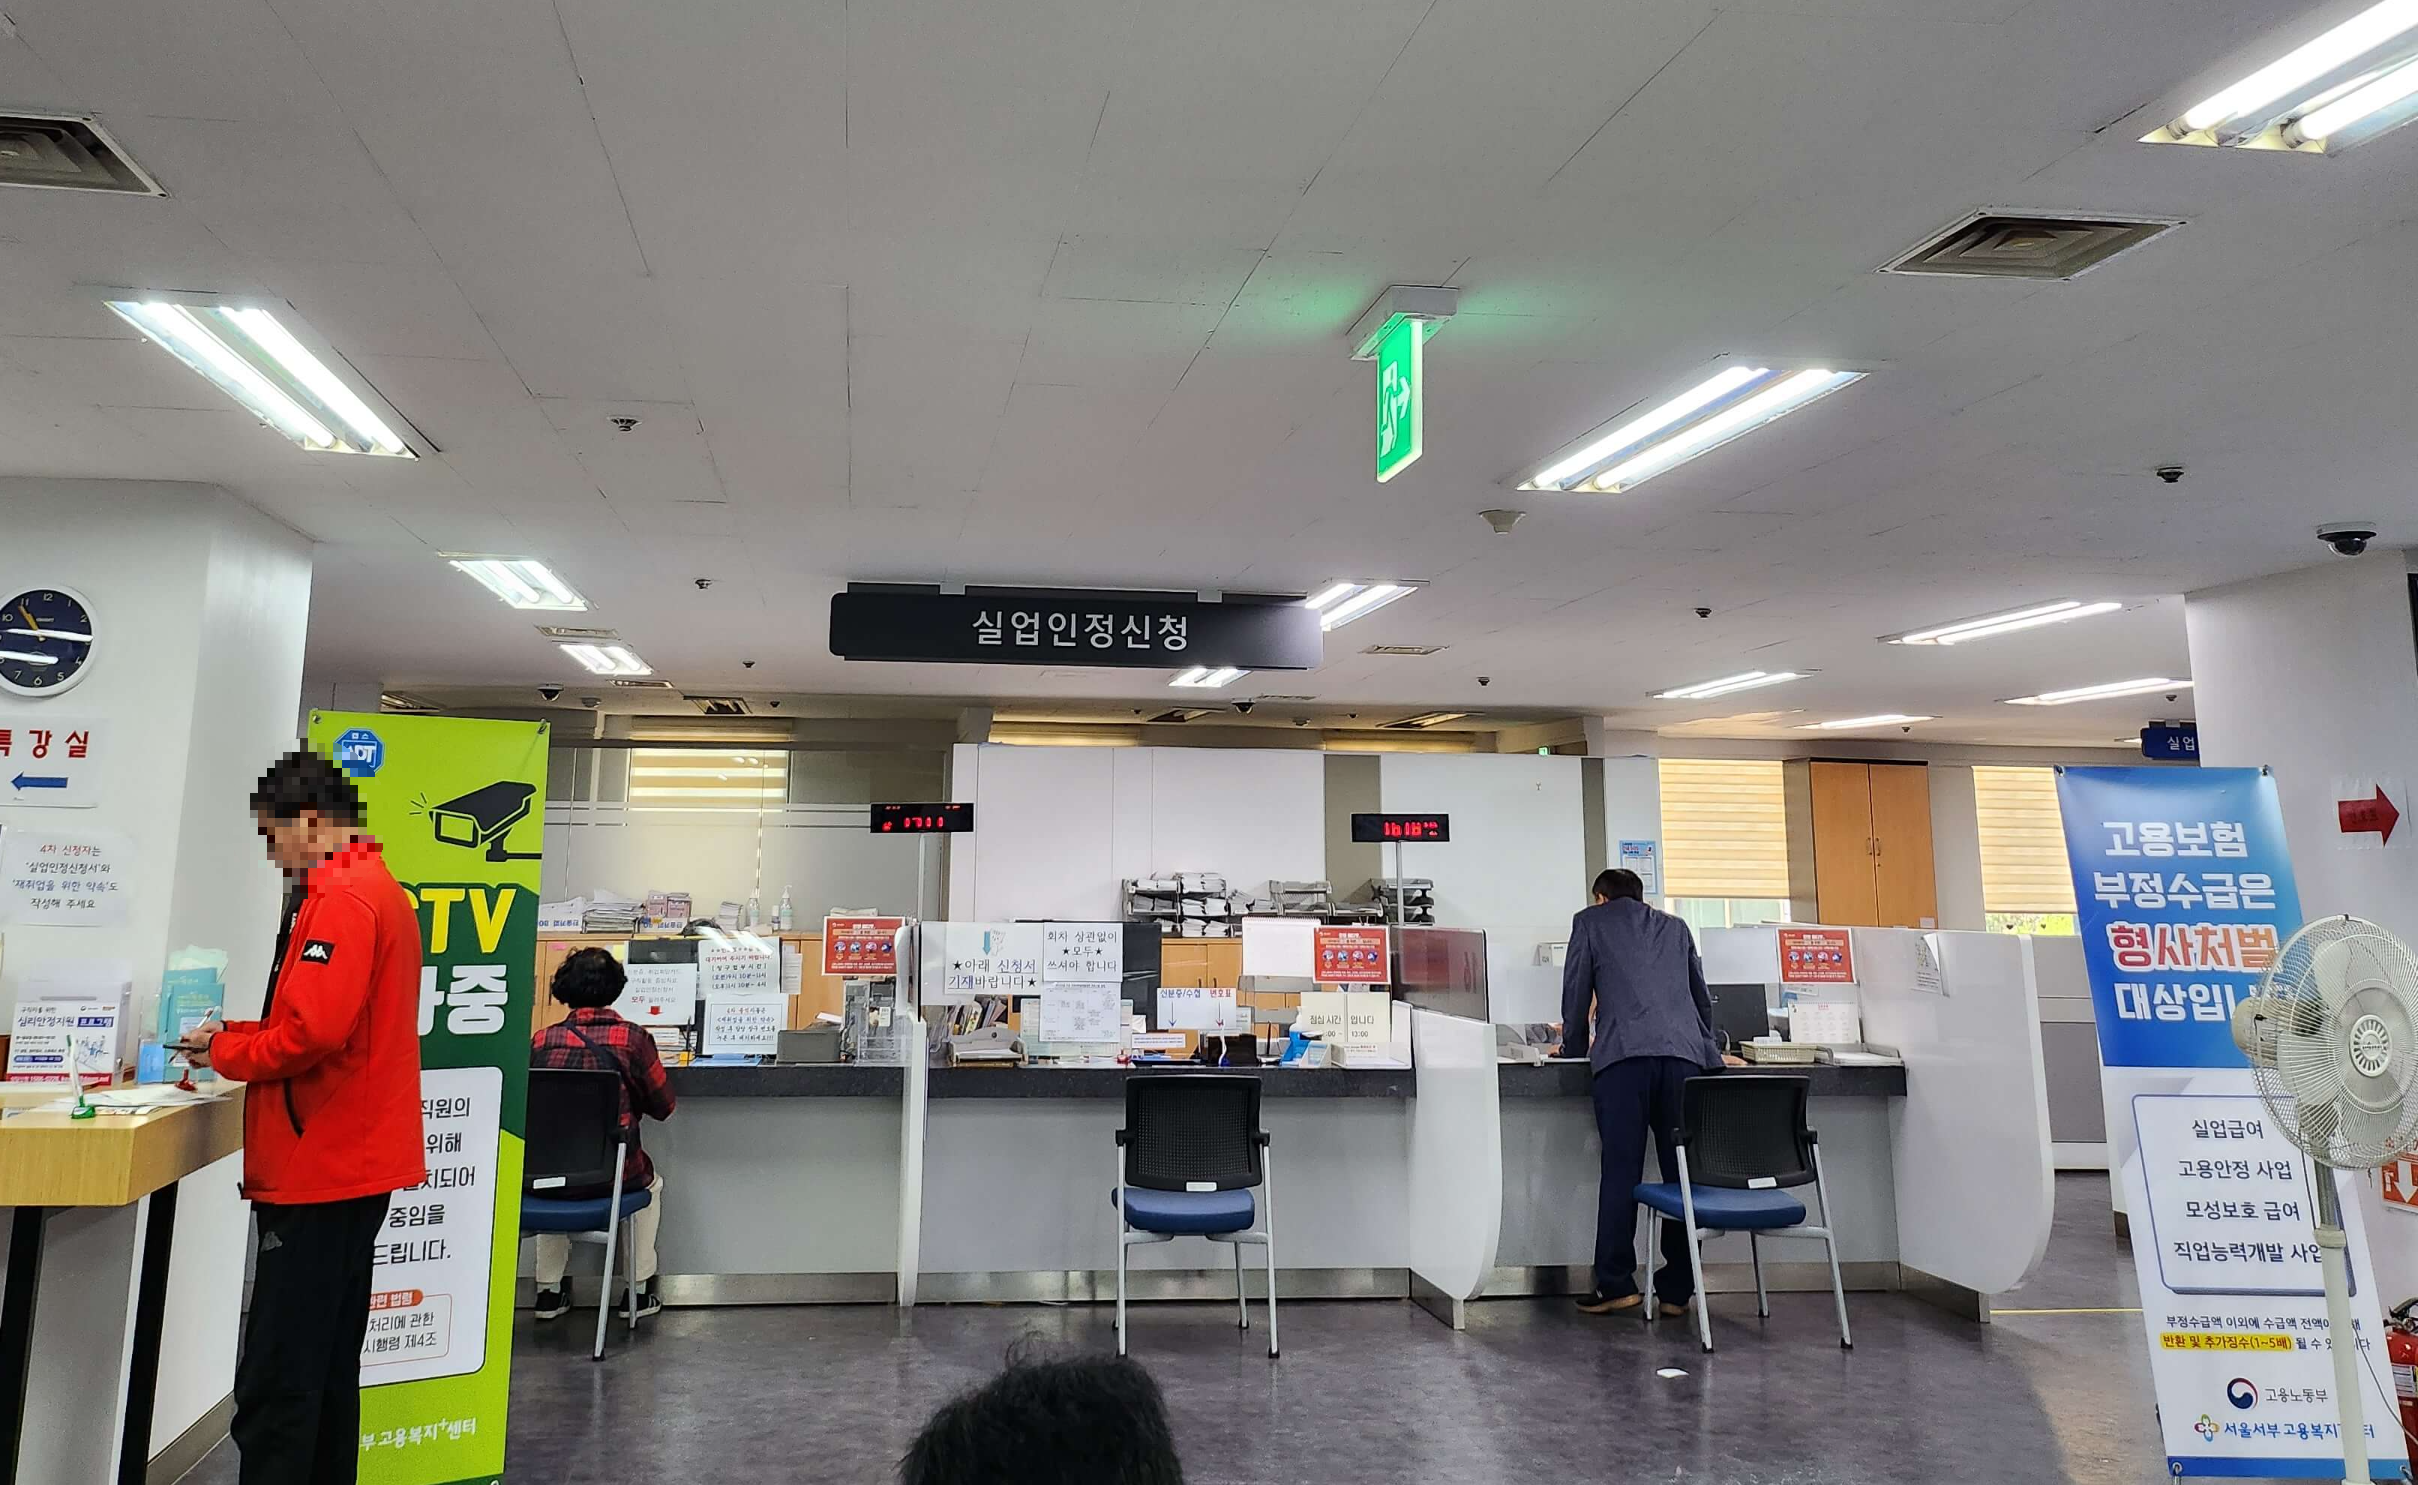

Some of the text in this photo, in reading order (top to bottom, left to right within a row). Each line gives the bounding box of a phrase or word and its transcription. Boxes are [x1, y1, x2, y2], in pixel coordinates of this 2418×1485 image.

[43, 593, 53, 601] 12
[973, 611, 1189, 650] 실업인정신청
[15, 670, 22, 679] 7
[34, 676, 42, 686] 6
[57, 672, 64, 680] 5
[0, 730, 90, 758] 특강실
[2167, 736, 2195, 751] 실업
[349, 744, 376, 763] DT
[2102, 821, 2248, 857] 고용보험
[40, 844, 57, 854] 4차
[61, 881, 80, 892] 위한
[2093, 872, 2276, 909] 부정수급은
[31, 898, 96, 910] 작성해 주세요
[404, 888, 517, 954] TV
[1047, 931, 1117, 943] 회차 상관없이
[1072, 946, 1094, 957] 모두
[2106, 922, 2279, 972] 형사처벌
[964, 957, 1037, 974] 아래 신청서
[1086, 960, 1117, 973] 합니다
[948, 974, 1025, 990] 기재바랍니다
[1210, 989, 1232, 998] 번호표
[2113, 982, 2262, 1021] 대상입
[17, 1016, 76, 1027] 심리안정지원
[1310, 1015, 1374, 1024] 점심 시간 입니다
[421, 1097, 471, 1119] 직원의
[2192, 1119, 2265, 1140] 실업급여
[425, 1132, 462, 1154] 위해
[403, 1166, 476, 1192] 치되어
[2178, 1159, 2293, 1180] 고용안정 사업
[388, 1204, 446, 1228] 중임을
[2186, 1201, 2301, 1222] 모성보호 급여
[373, 1240, 452, 1266] 드립니다.
[2173, 1242, 2284, 1263] 직업능력개발
[369, 1311, 435, 1332] 처리에 관한
[2166, 1315, 2223, 1329] 부정수급액
[2226, 1316, 2260, 1329] 이외에
[2263, 1317, 2297, 1330] 수급액
[364, 1331, 438, 1354] 시행령 제4조
[2163, 1334, 2186, 1348] 반환
[2189, 1335, 2200, 1348] 및
[2204, 1337, 2292, 1350] 추가징수(1~5배)
[2310, 1338, 2322, 1350] 수
[2265, 1388, 2328, 1403] 고용노동부
[2224, 1422, 2375, 1441] 서울서부 고용복지터
